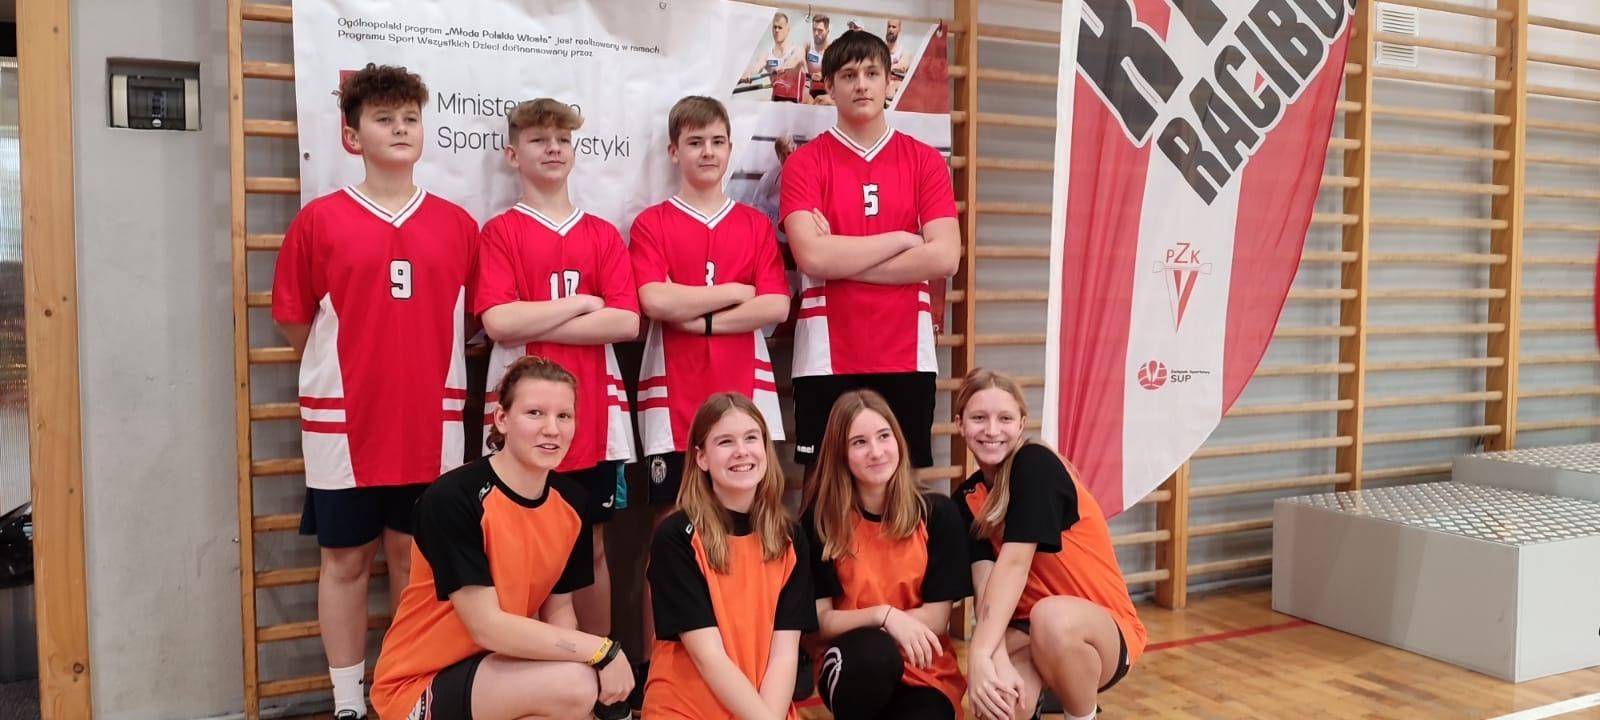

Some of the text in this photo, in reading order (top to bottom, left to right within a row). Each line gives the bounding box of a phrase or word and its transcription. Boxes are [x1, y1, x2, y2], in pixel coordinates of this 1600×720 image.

[337, 18, 401, 31] Ogólnopolski
[404, 24, 442, 36] program
[482, 30, 514, 41] Polskie
[555, 37, 572, 46] jest
[575, 38, 620, 51] realizowany
[630, 45, 660, 54] ramach
[338, 30, 593, 58] Programu Sport Wszystkich Dzieci dofinansowany przez
[862, 183, 880, 217] 5
[1166, 242, 1200, 263] PZK
[389, 259, 413, 300] 9
[1170, 374, 1192, 383] SUP
